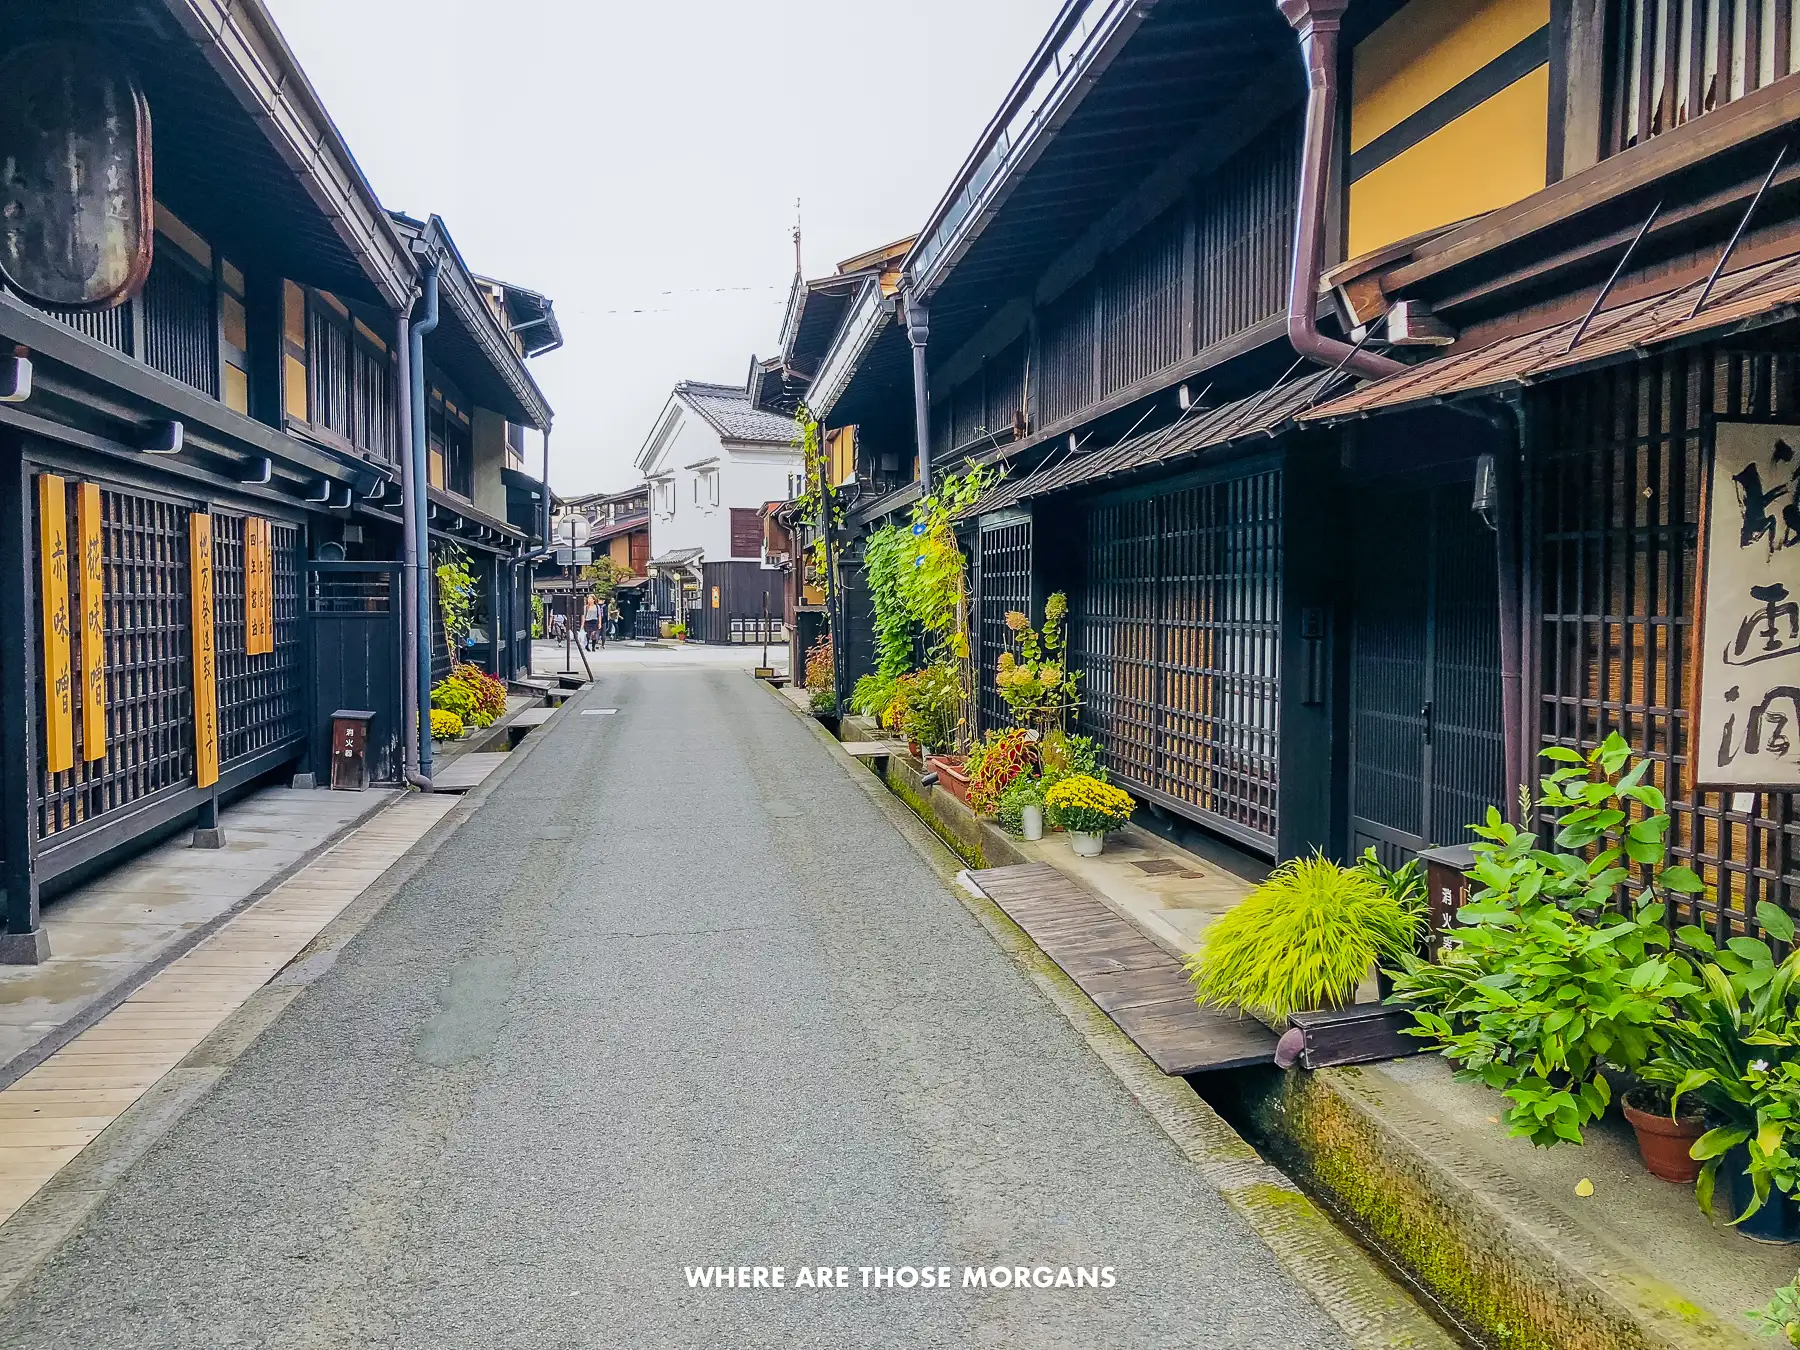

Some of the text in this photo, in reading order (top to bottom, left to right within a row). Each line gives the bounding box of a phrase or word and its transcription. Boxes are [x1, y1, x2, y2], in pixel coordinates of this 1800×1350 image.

[51, 530, 70, 714] 赤味噌
[345, 728, 354, 757] 消火器
